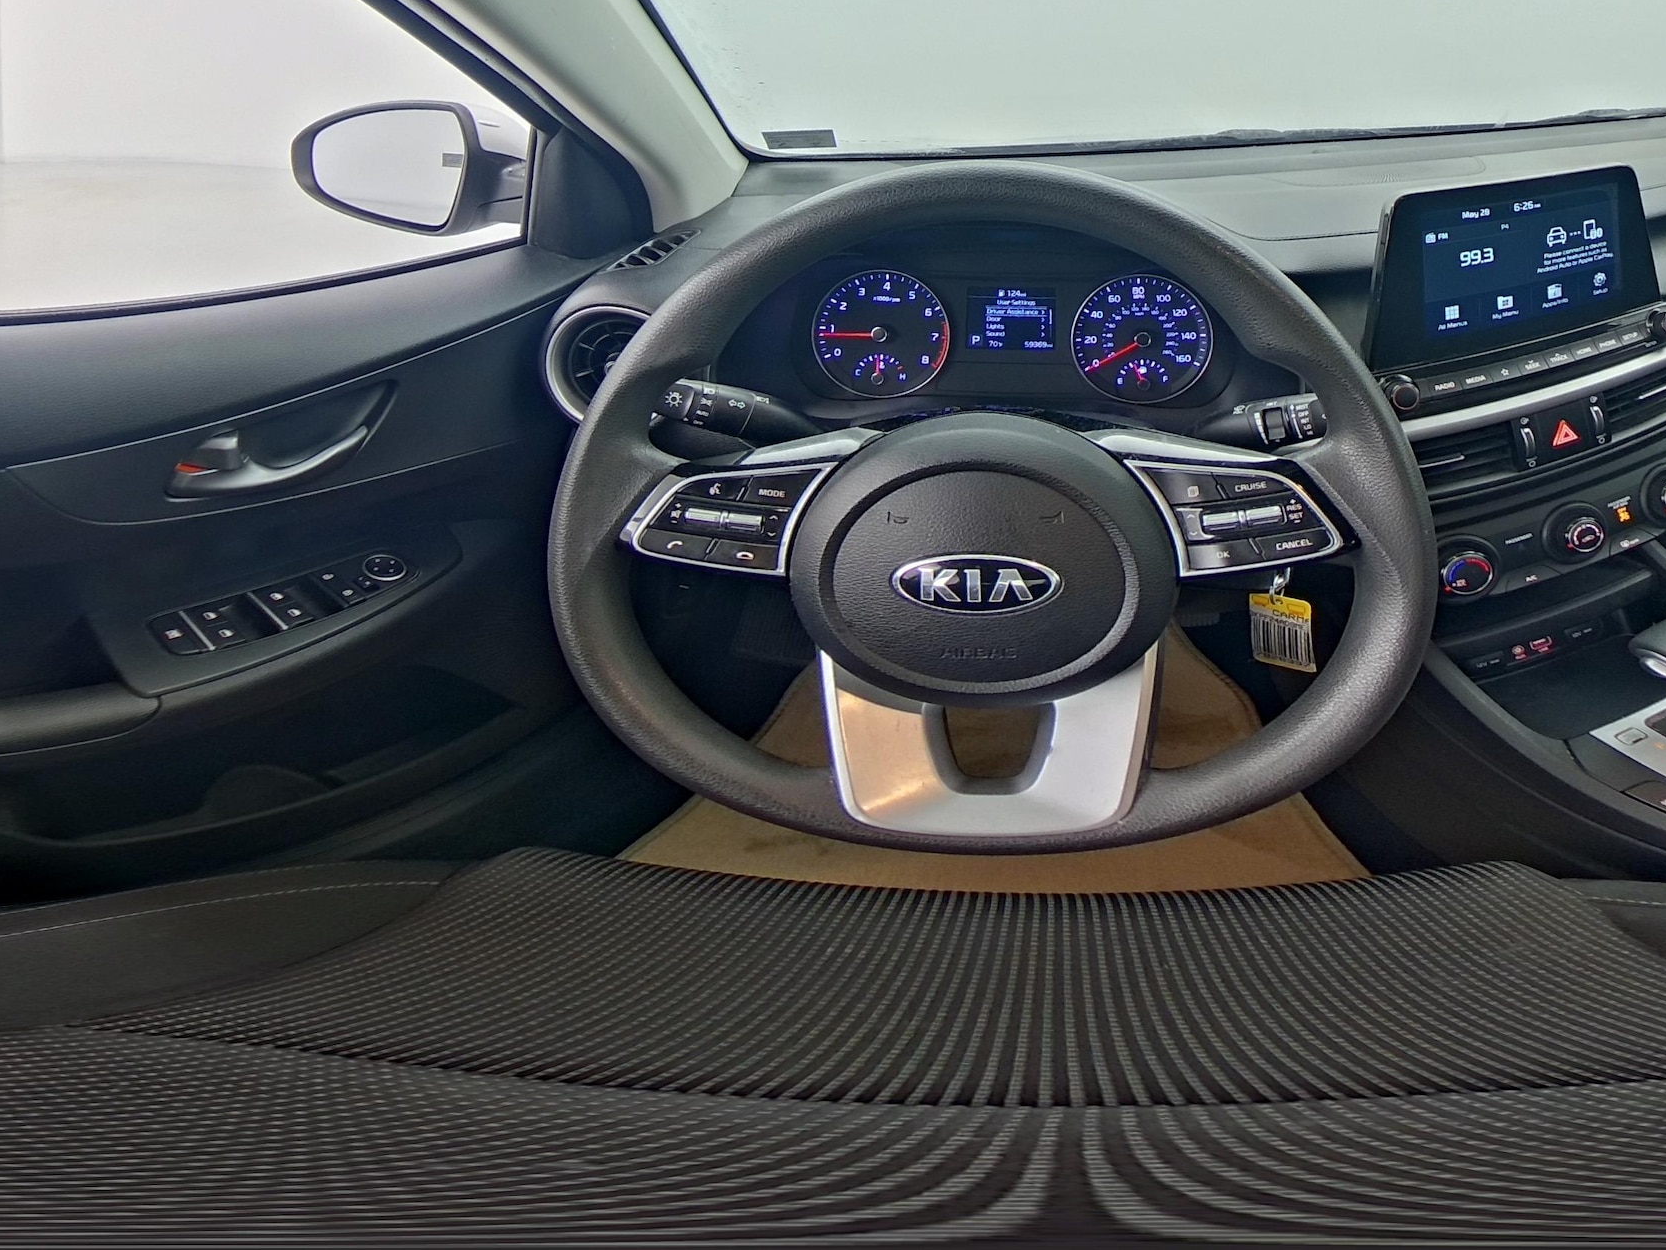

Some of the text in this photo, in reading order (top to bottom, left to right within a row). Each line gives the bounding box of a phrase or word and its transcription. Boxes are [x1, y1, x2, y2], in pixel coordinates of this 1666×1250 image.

[1461, 208, 1490, 220] May 28
[1437, 232, 1449, 241] FM
[1459, 247, 1494, 268] 99.3
[883, 282, 891, 291] 4
[858, 288, 865, 296] 3
[1132, 287, 1145, 295] 80
[908, 291, 916, 300] 5
[1108, 295, 1121, 303] 60
[1156, 294, 1171, 303] 100
[839, 302, 847, 310] 2
[924, 308, 932, 317] 6
[1090, 311, 1103, 319] 40
[1173, 309, 1187, 317] 120
[931, 333, 939, 341] 7
[972, 335, 981, 345] P
[1084, 336, 1097, 344] 20
[1181, 332, 1196, 340] 140
[834, 348, 841, 356] 0
[921, 356, 929, 364] 8
[1175, 355, 1191, 363] 160
[1434, 381, 1456, 391] RADIO
[1465, 375, 1487, 385] MEDIA
[1235, 481, 1267, 493] CRUISE
[758, 488, 786, 498] MODE
[1286, 503, 1303, 511] RES
[1288, 512, 1304, 520] SET
[1275, 538, 1313, 550] CANCEL
[1216, 551, 1231, 559] OK
[918, 568, 1033, 602] KIA
